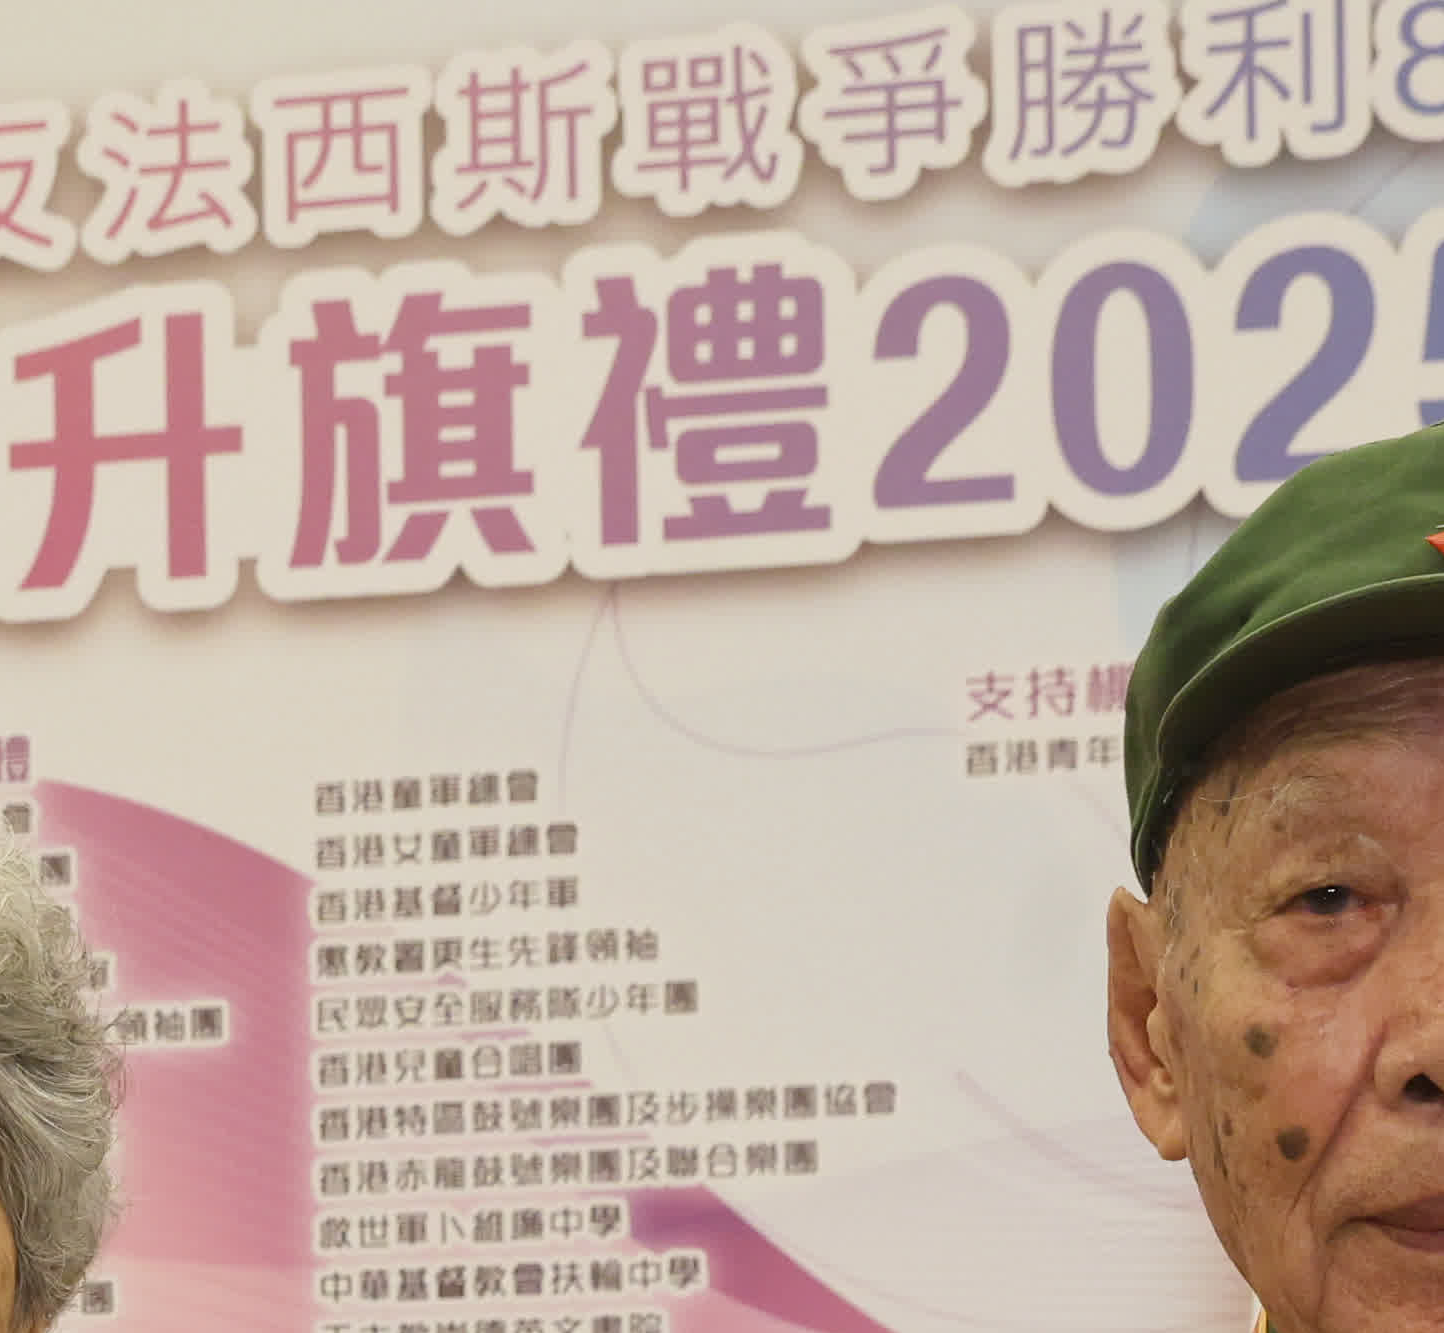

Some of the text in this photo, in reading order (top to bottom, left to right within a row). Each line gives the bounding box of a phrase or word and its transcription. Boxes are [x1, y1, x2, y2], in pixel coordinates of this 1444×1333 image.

[315, 770, 539, 816] 香港童軍總會
[315, 823, 579, 869] 香港女童軍總會
[316, 876, 579, 923] 香港基督少年軍
[319, 1042, 582, 1086] 香港兒童合唱團
[321, 1255, 702, 1304] 中華基督教會扶輪中學
